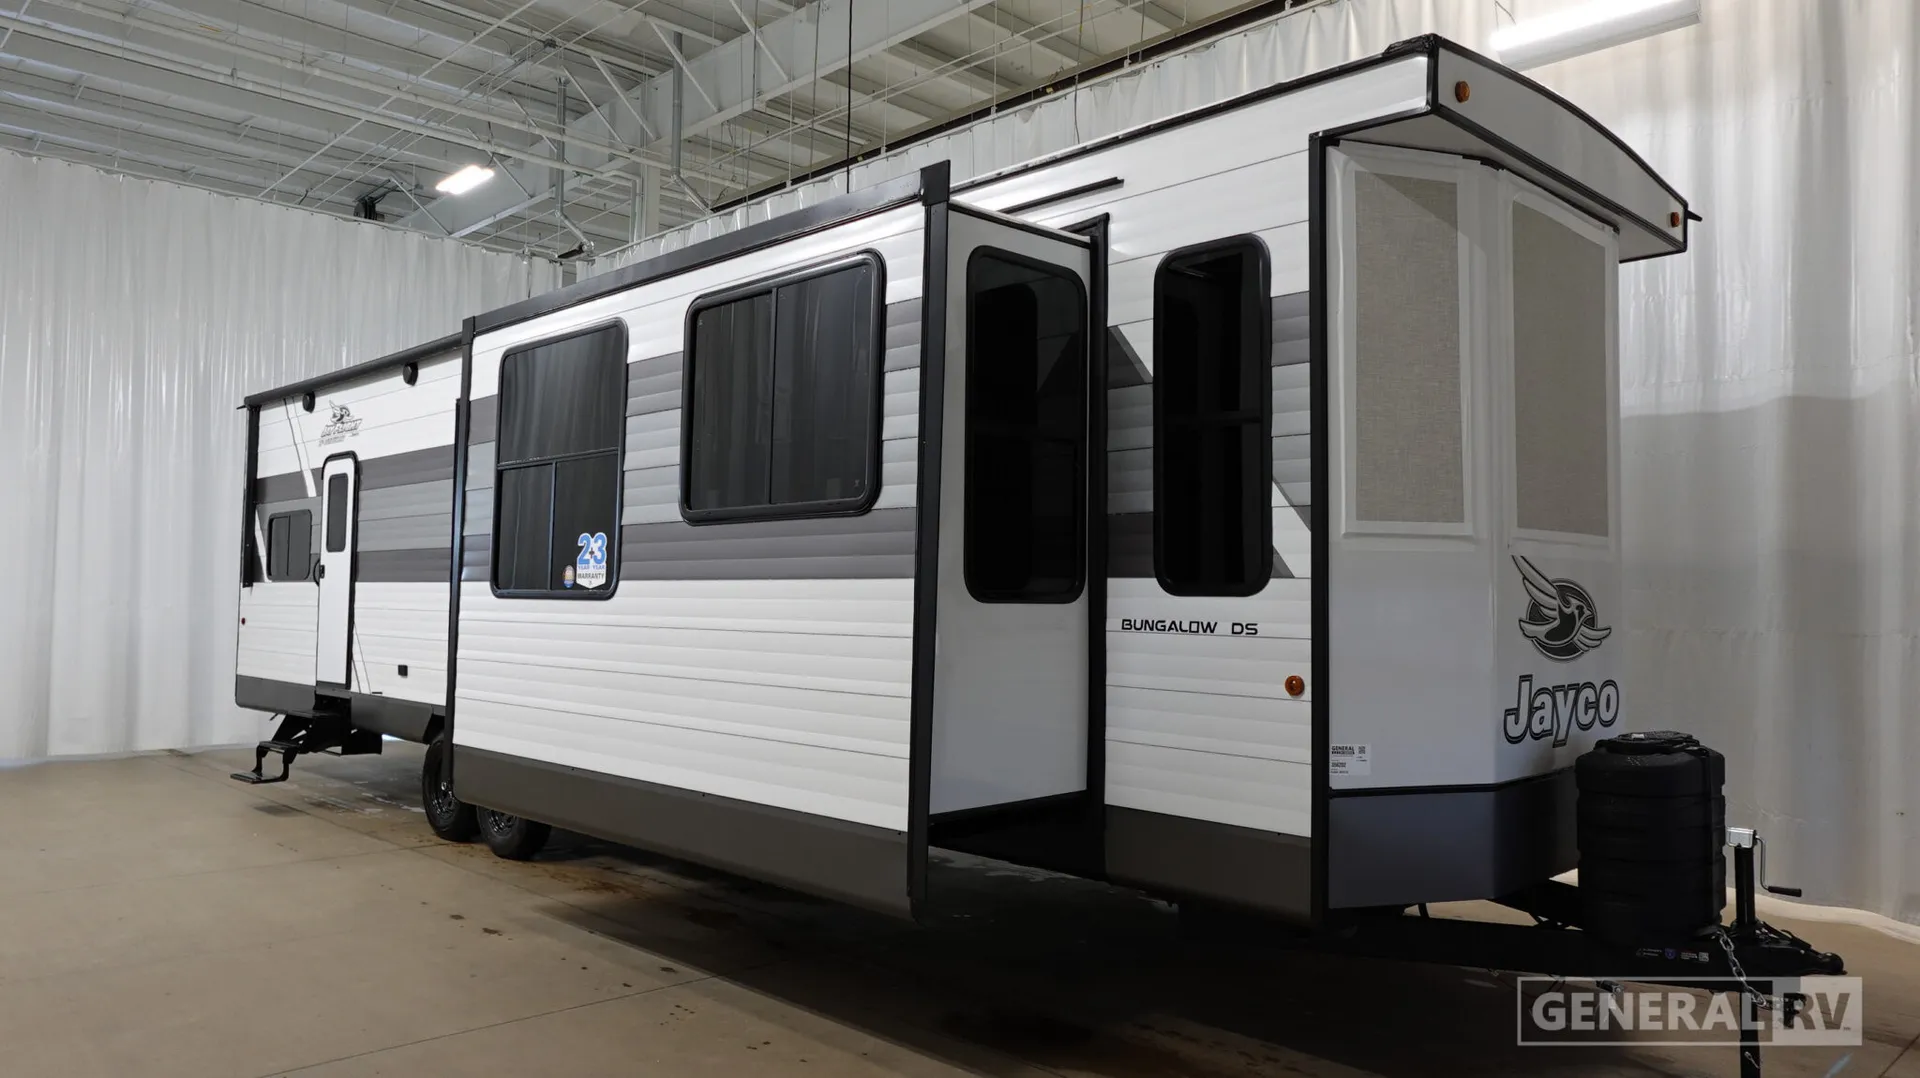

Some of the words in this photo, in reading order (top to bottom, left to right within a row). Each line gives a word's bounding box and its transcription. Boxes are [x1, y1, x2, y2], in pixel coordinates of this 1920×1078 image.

[1121, 618, 1218, 634] BUNGALOW
[1231, 622, 1259, 636] DS
[1503, 673, 1620, 749] Jayco
